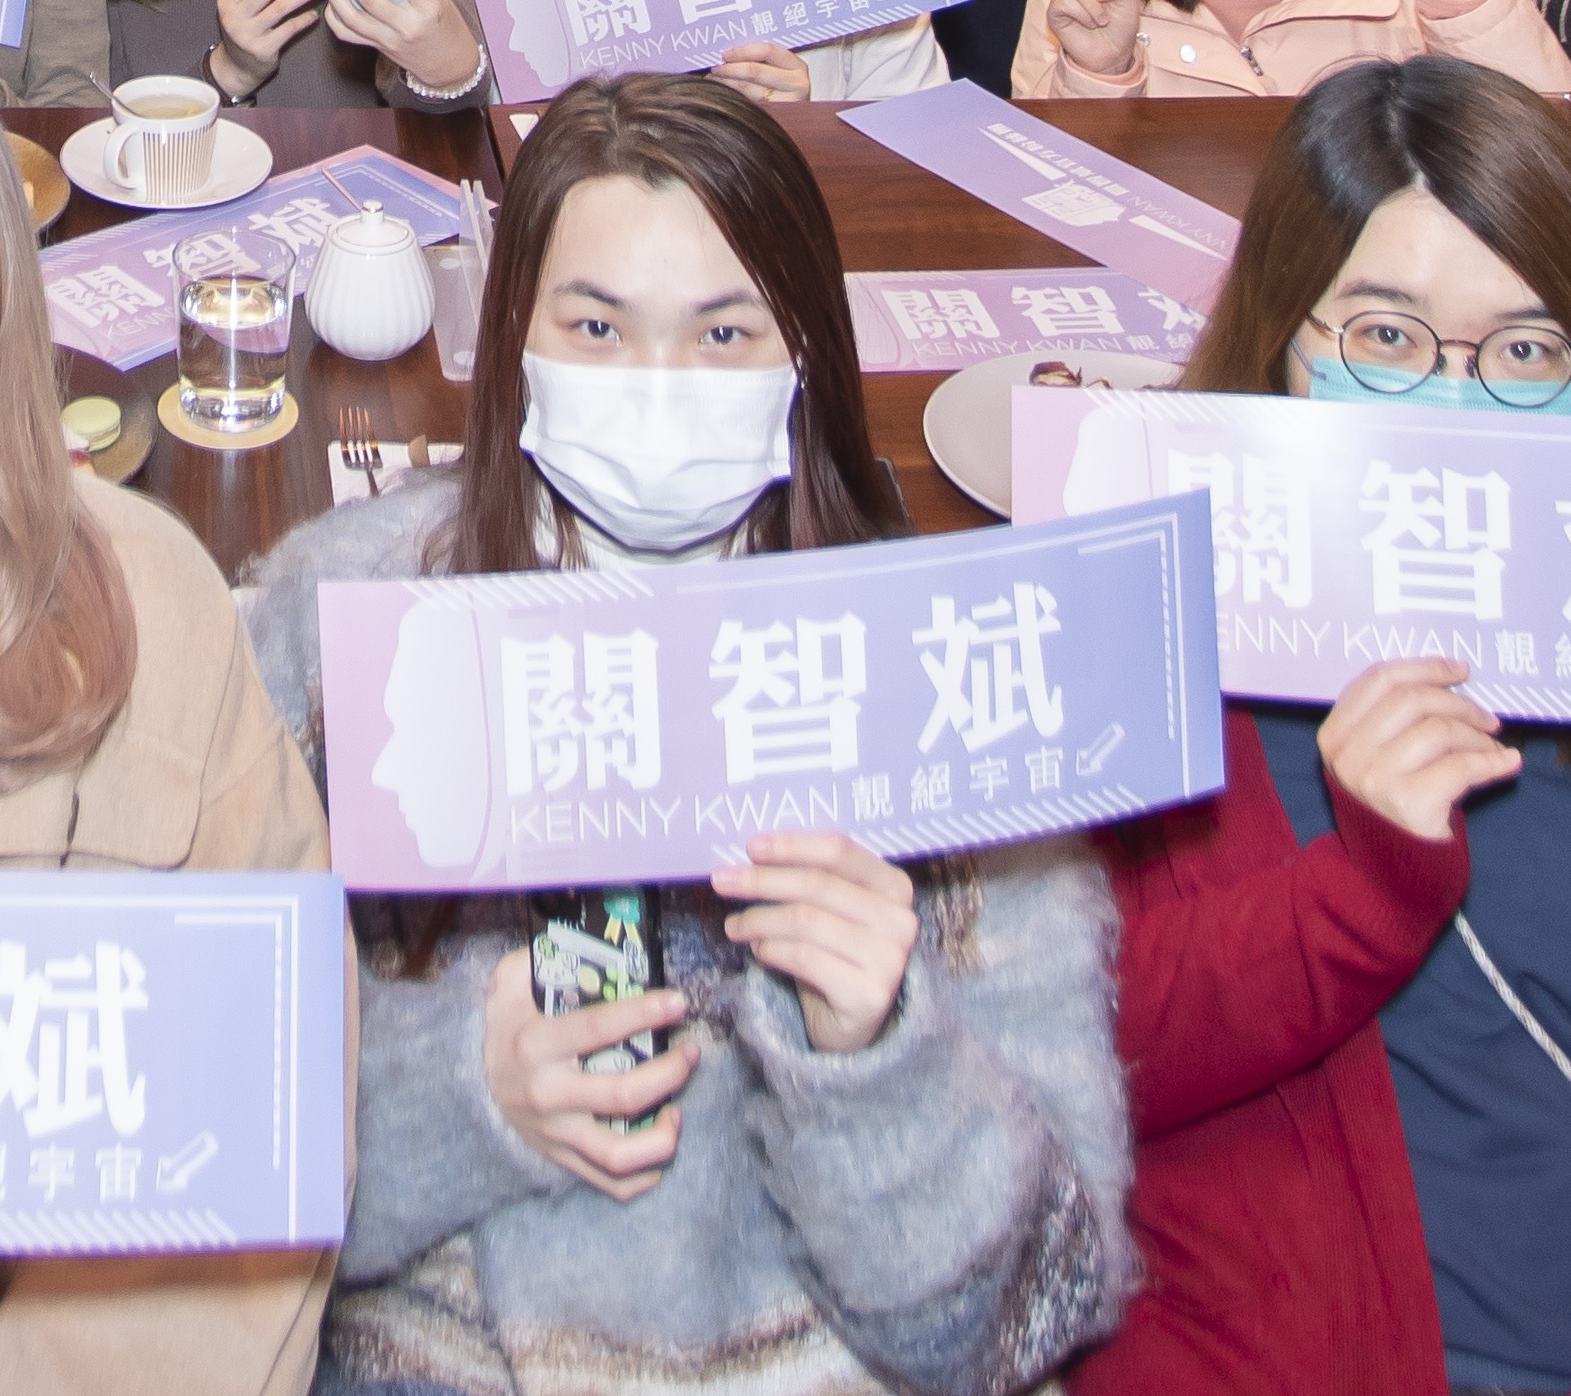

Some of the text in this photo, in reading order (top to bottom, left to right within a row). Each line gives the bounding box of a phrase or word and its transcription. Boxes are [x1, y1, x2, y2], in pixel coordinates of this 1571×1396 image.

[579, 33, 666, 71] KENNY
[670, 18, 750, 54] KWAN
[101, 305, 178, 340] KENN
[912, 339, 1019, 358] KENNY
[1026, 336, 1124, 355] KWAN
[1342, 619, 1486, 670] KWAN
[501, 580, 1065, 796] 關智斌
[510, 794, 683, 845] KENNY
[692, 781, 840, 837] KWAN
